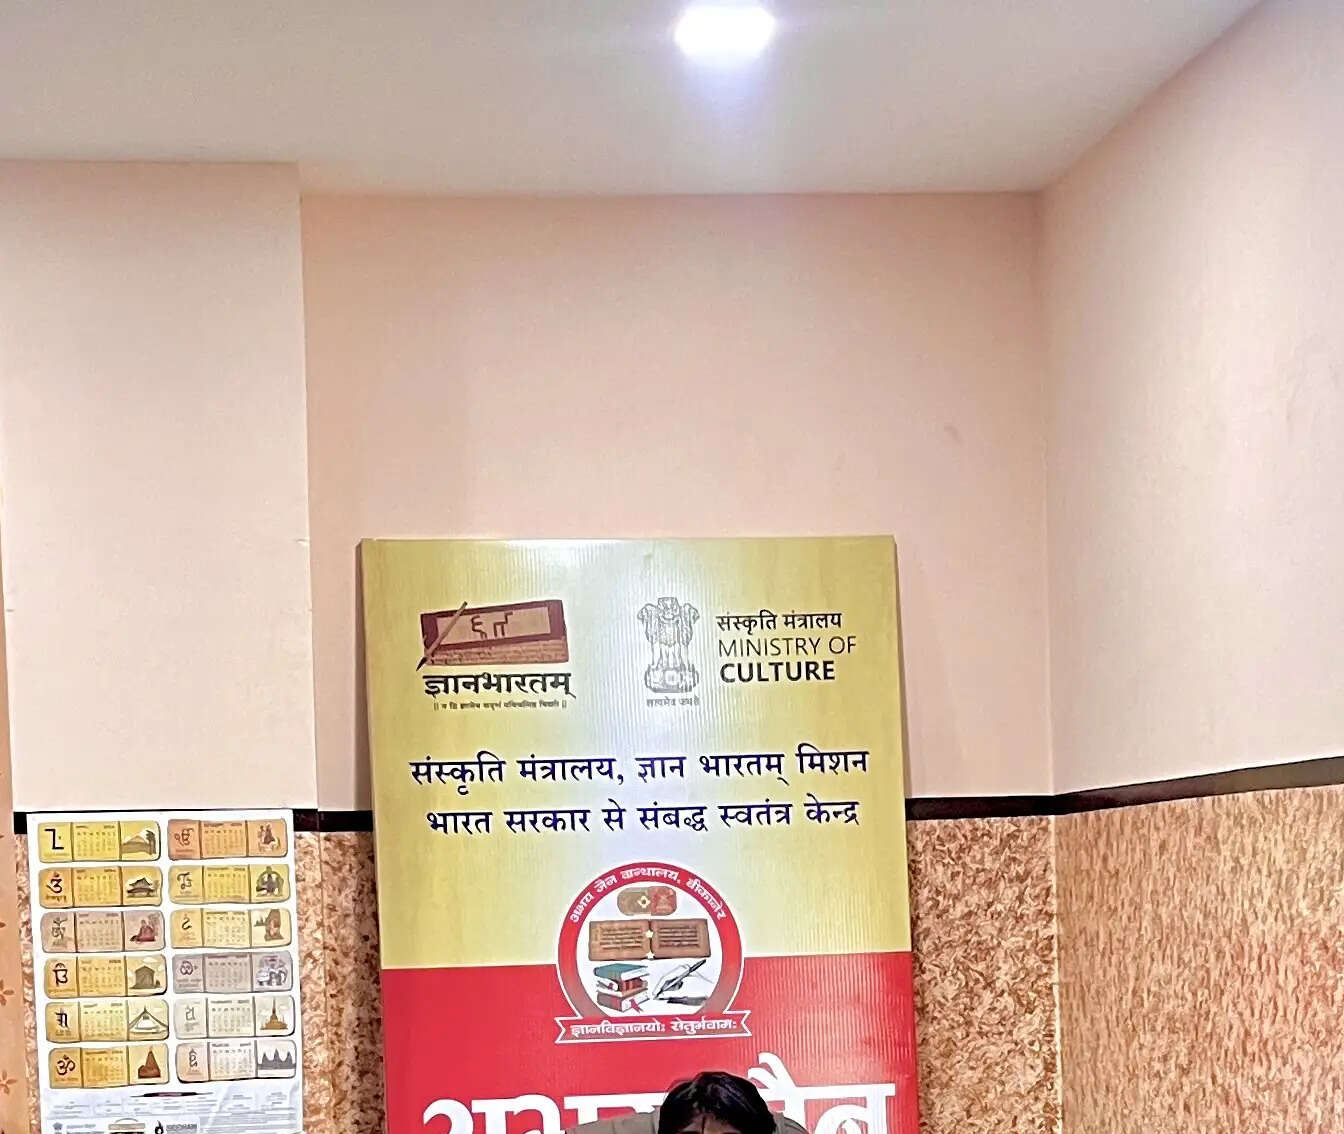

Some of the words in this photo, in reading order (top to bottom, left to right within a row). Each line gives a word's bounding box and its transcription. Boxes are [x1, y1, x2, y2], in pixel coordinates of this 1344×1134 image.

[716, 609, 777, 635] संस्कृति
[784, 610, 842, 630] मंत्रालय
[718, 637, 821, 658] MINISTRY
[828, 635, 857, 654] OF
[719, 660, 836, 683] CULTURE
[422, 672, 577, 698] ज्ञानभारतम्
[409, 750, 506, 796] संस्कृति
[516, 754, 624, 785] मंत्रालय,
[635, 756, 687, 783] ज्ञान
[699, 753, 790, 786] भारतम्
[795, 743, 870, 775] मिशन
[426, 810, 493, 835] भारत
[504, 809, 591, 833] सरकार
[602, 798, 627, 832] से
[636, 801, 709, 832] संबद्ध
[717, 798, 793, 828] स्वतंत्र
[804, 792, 860, 826] केन्द्र
